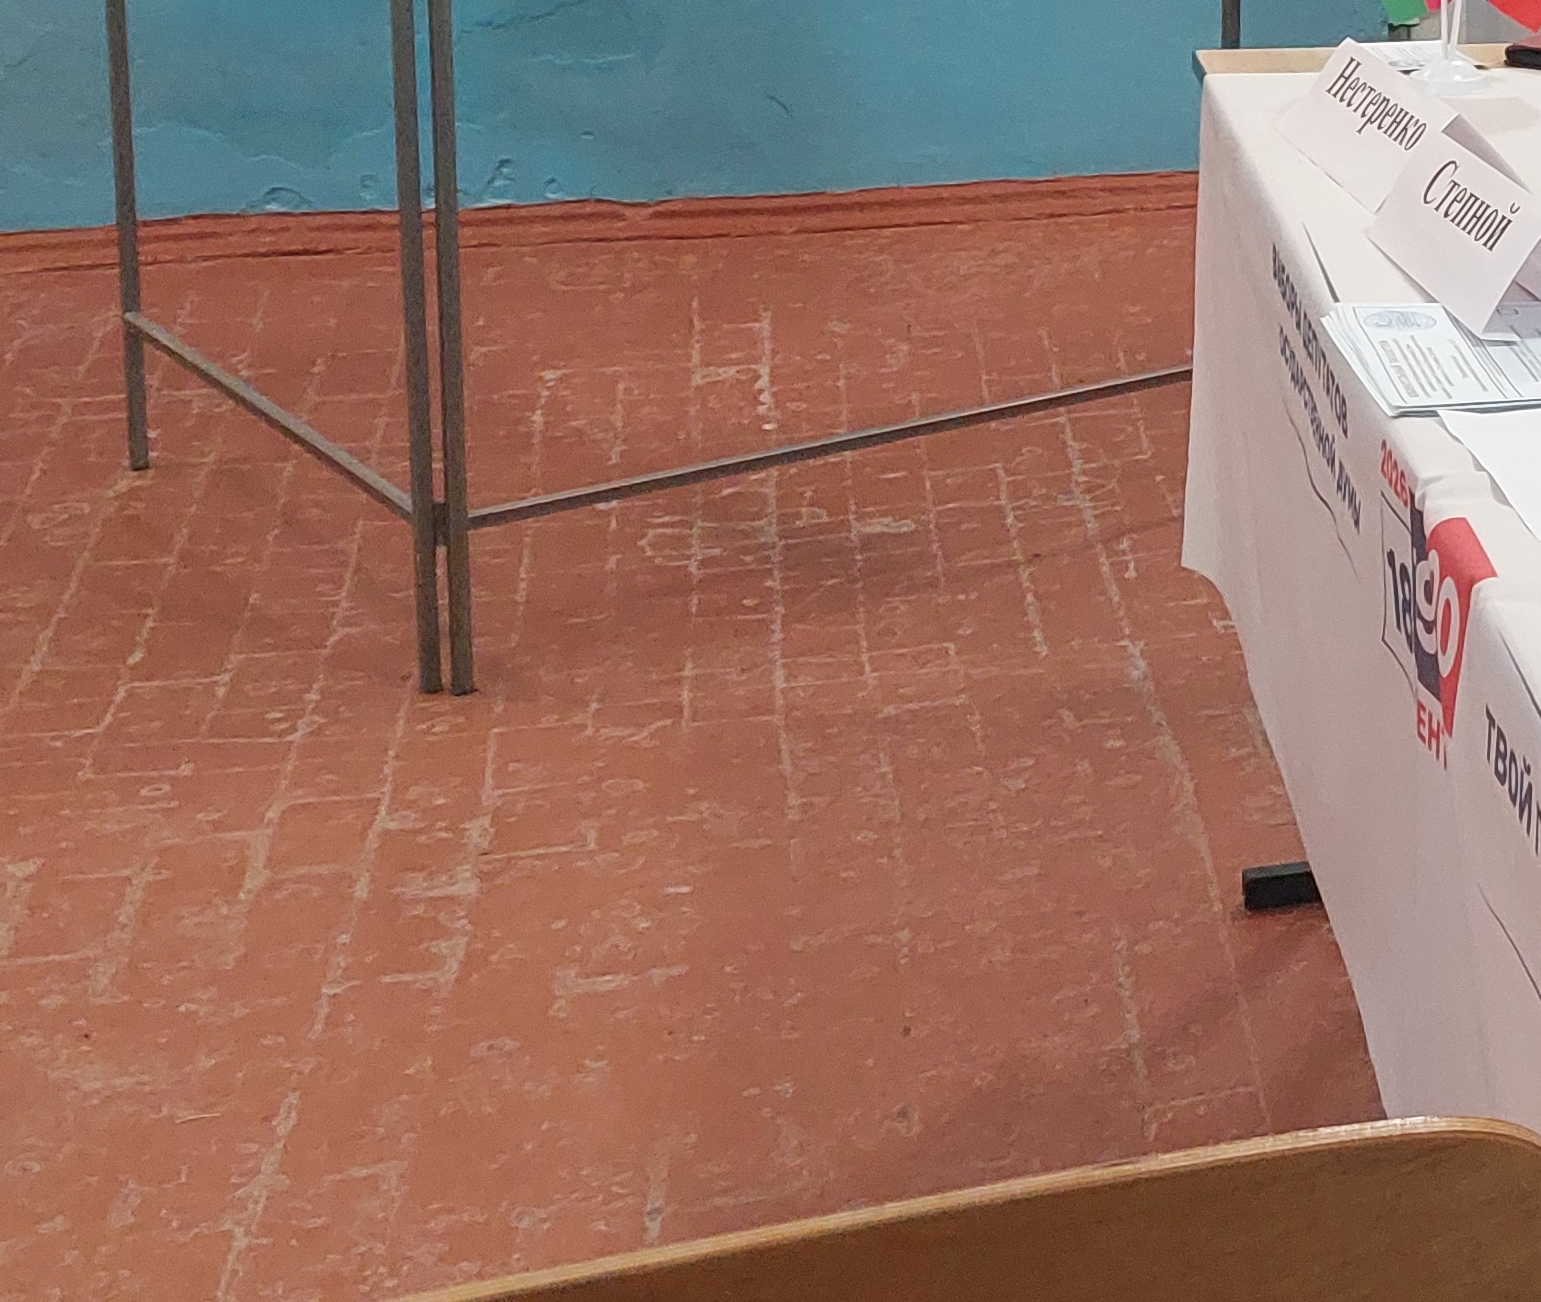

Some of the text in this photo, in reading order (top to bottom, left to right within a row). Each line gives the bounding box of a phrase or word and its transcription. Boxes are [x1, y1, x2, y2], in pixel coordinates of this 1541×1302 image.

[1325, 56, 1428, 151] Нестеренко
[1423, 159, 1521, 253] Степной
[1380, 438, 1409, 510] 2026
[1386, 547, 1413, 655] 18
[1485, 702, 1534, 838] ТВОЙ
